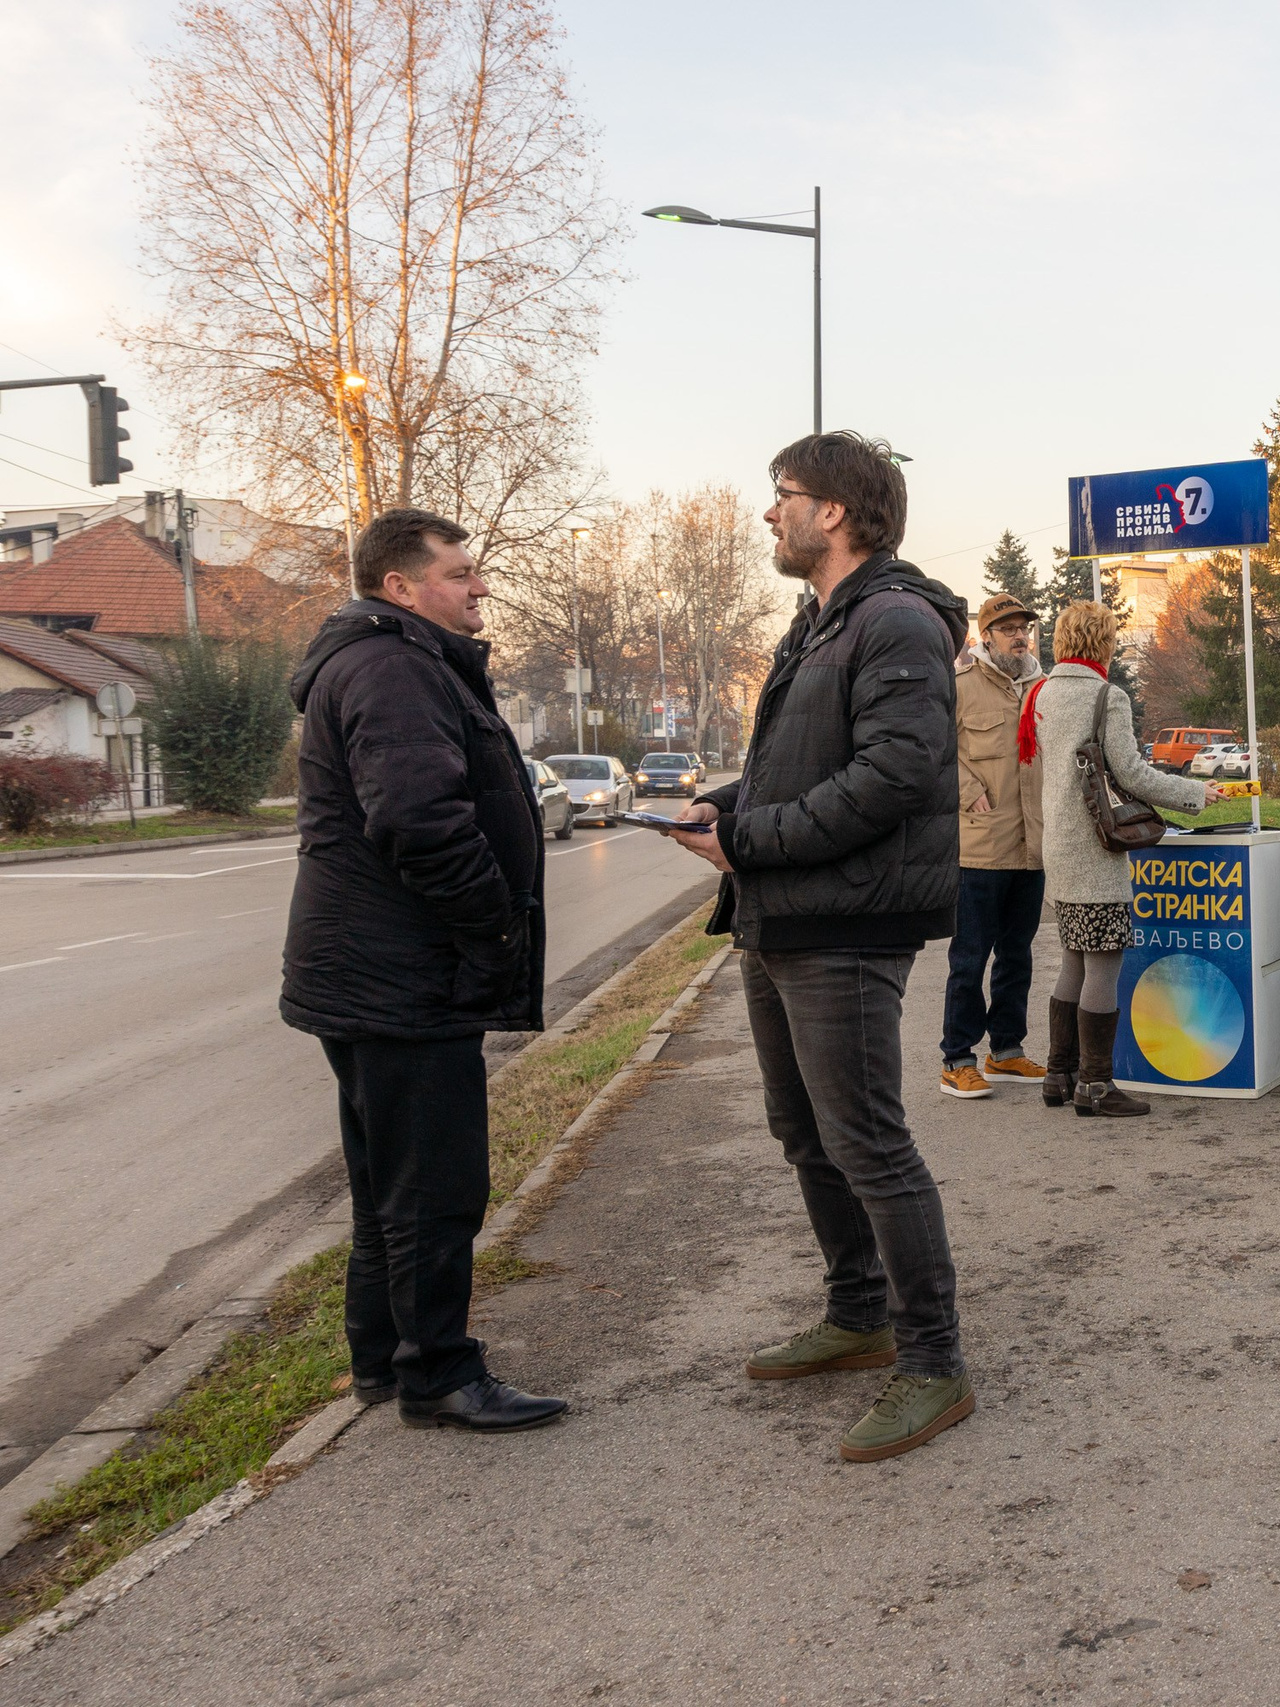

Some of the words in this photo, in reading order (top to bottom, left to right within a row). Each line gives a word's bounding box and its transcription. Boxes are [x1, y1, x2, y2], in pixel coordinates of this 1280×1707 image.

[1116, 503, 1171, 517] СРБИЈА
[1185, 488, 1207, 515] 7.
[1116, 514, 1171, 527] ПРОТИВ
[1116, 525, 1174, 538] НАСИЉА
[1129, 860, 1243, 887] КРАТСКА
[1133, 892, 1243, 921] СТРАНКА
[1134, 928, 1244, 950] ВАЉЕВО
